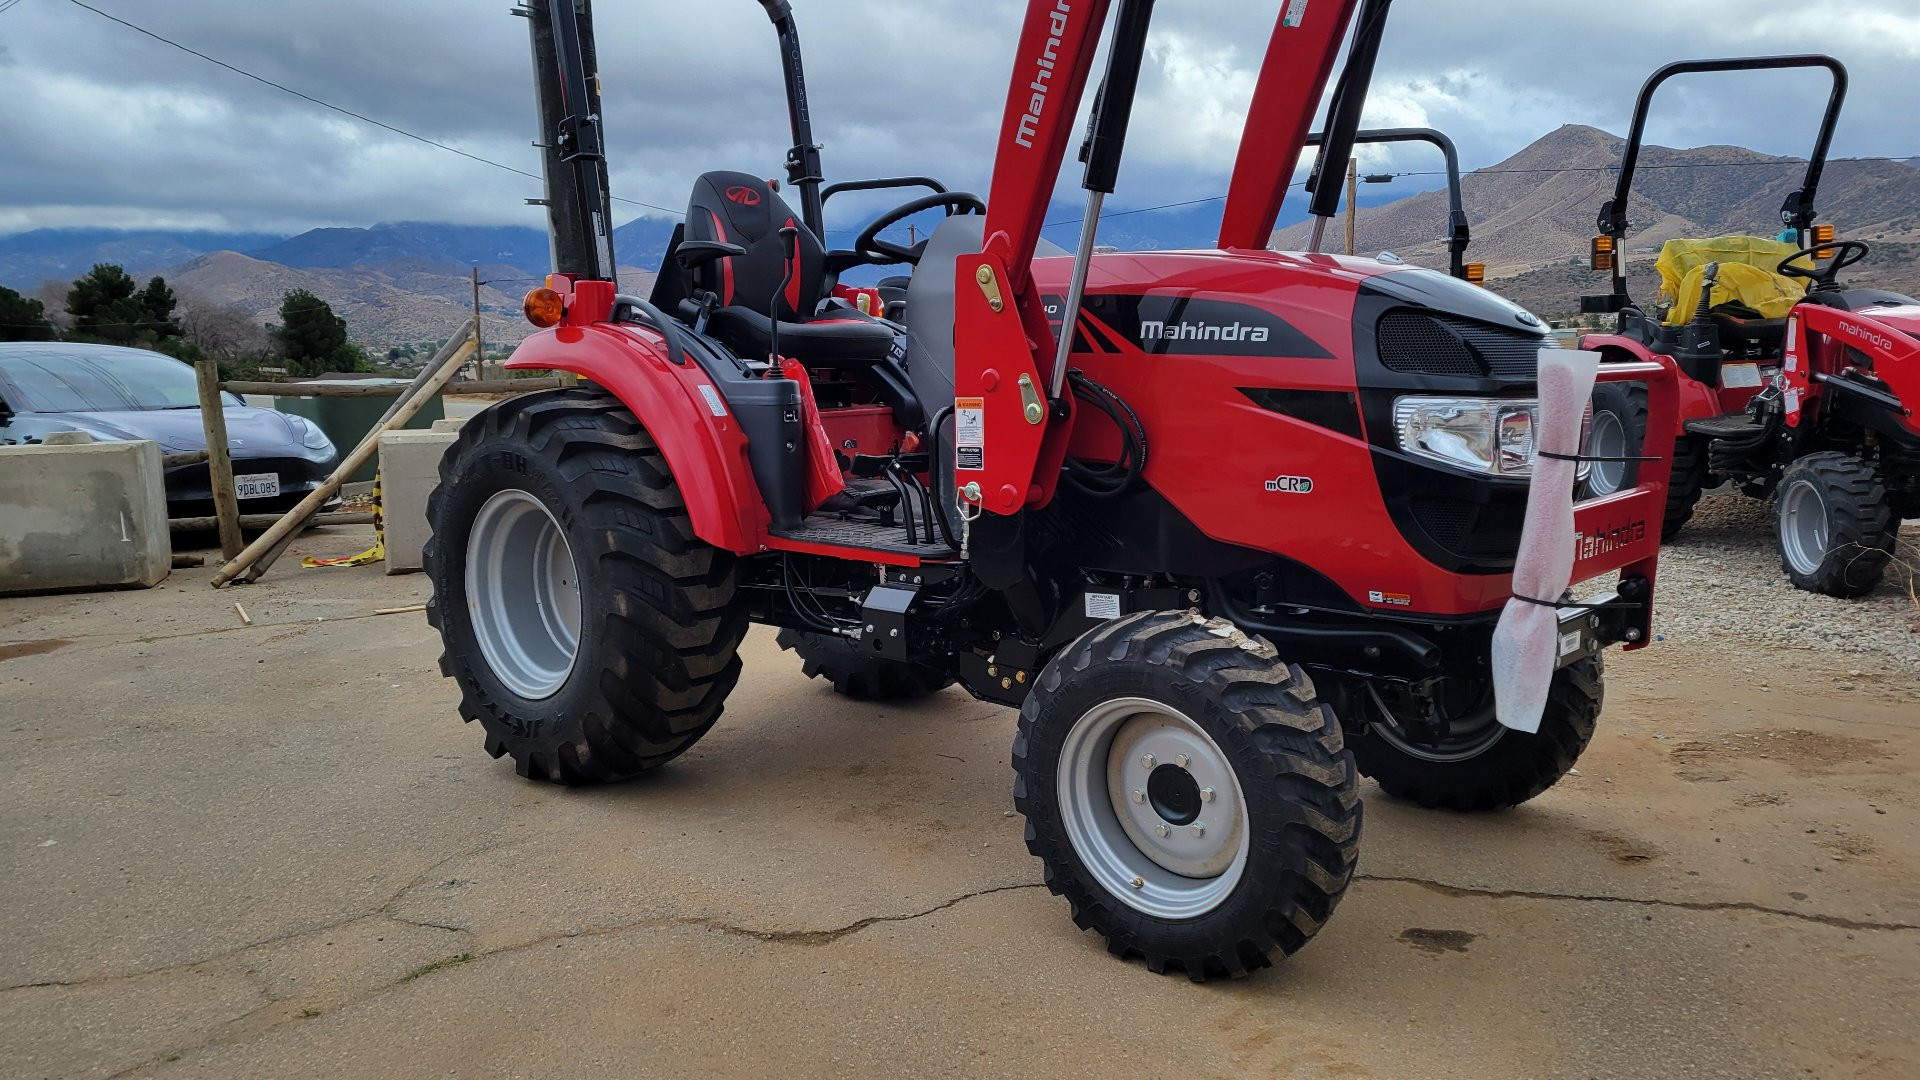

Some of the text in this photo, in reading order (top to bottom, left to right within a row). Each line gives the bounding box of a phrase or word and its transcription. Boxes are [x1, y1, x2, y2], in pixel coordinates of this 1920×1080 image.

[1015, 0, 1070, 149] Mahindr
[1043, 305, 1058, 314] 0
[1140, 320, 1269, 342] Mahindra
[237, 481, 277, 496] 9DBL085
